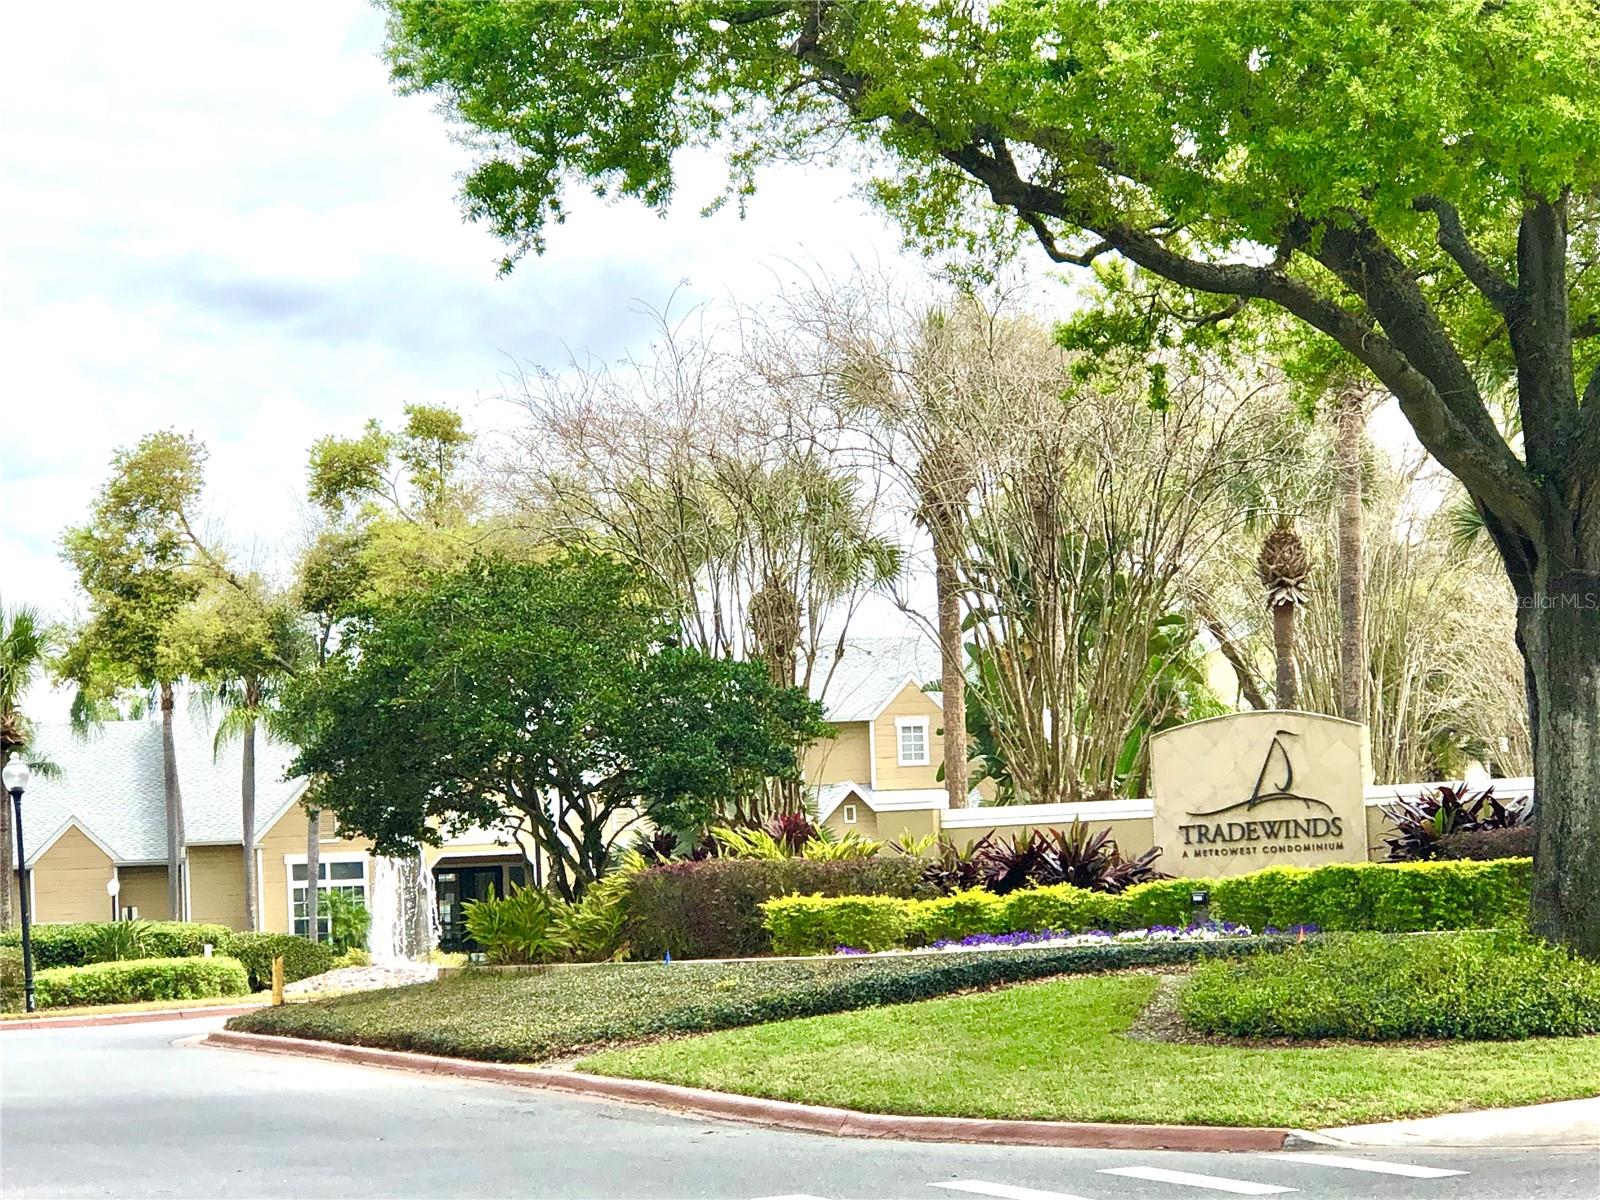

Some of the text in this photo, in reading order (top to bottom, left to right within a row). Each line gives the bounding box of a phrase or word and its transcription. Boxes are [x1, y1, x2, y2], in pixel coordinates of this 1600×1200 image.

[1179, 817, 1343, 845] TRADEWINDS
[1182, 842, 1344, 858] A METROWEST CONDOMINIUM
